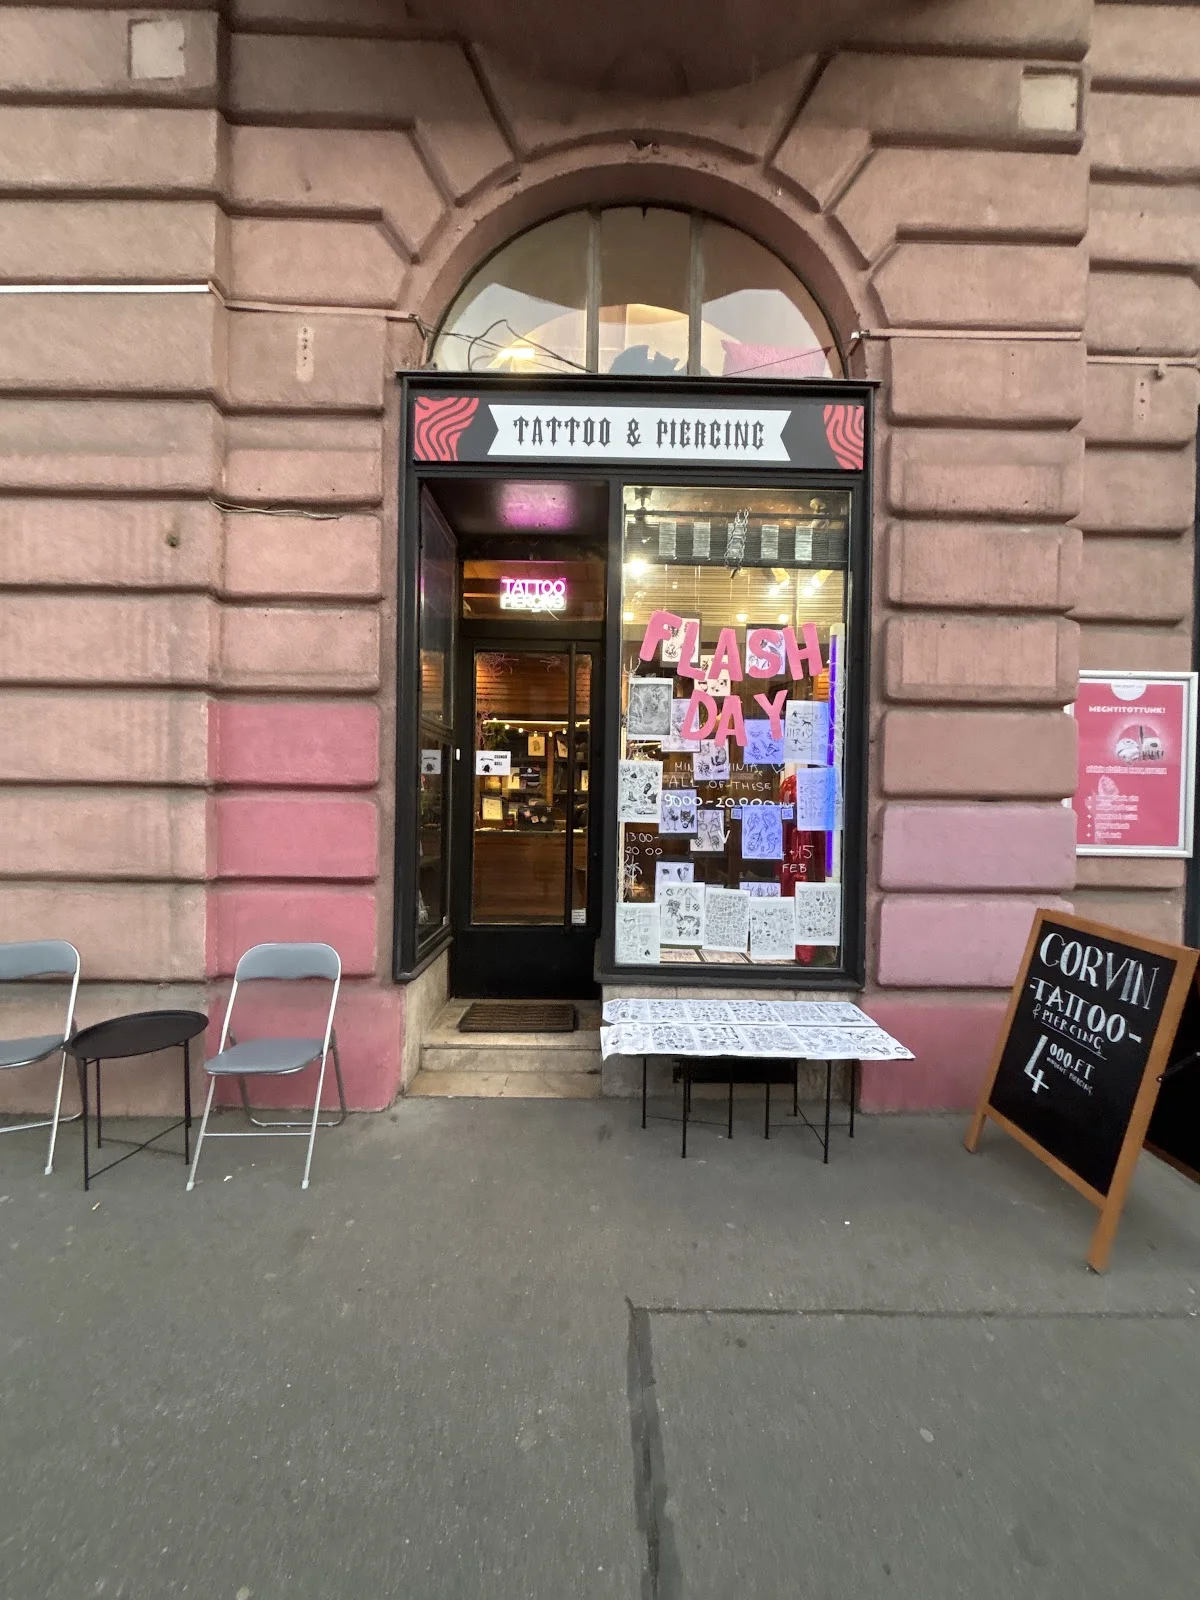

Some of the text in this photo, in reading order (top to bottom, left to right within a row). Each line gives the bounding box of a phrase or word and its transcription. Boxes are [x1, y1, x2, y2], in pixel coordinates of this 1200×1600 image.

[513, 416, 765, 450] TATTOO & PIERCING
[502, 579, 566, 595] TATTOO
[639, 609, 823, 682] FLASH
[681, 689, 788, 748] DAY
[668, 775, 699, 788] ALL
[734, 781, 771, 791] THESE
[782, 863, 807, 873] FEB
[1040, 932, 1160, 1010] CORVIN
[1041, 1009, 1104, 1055] PIERCING
